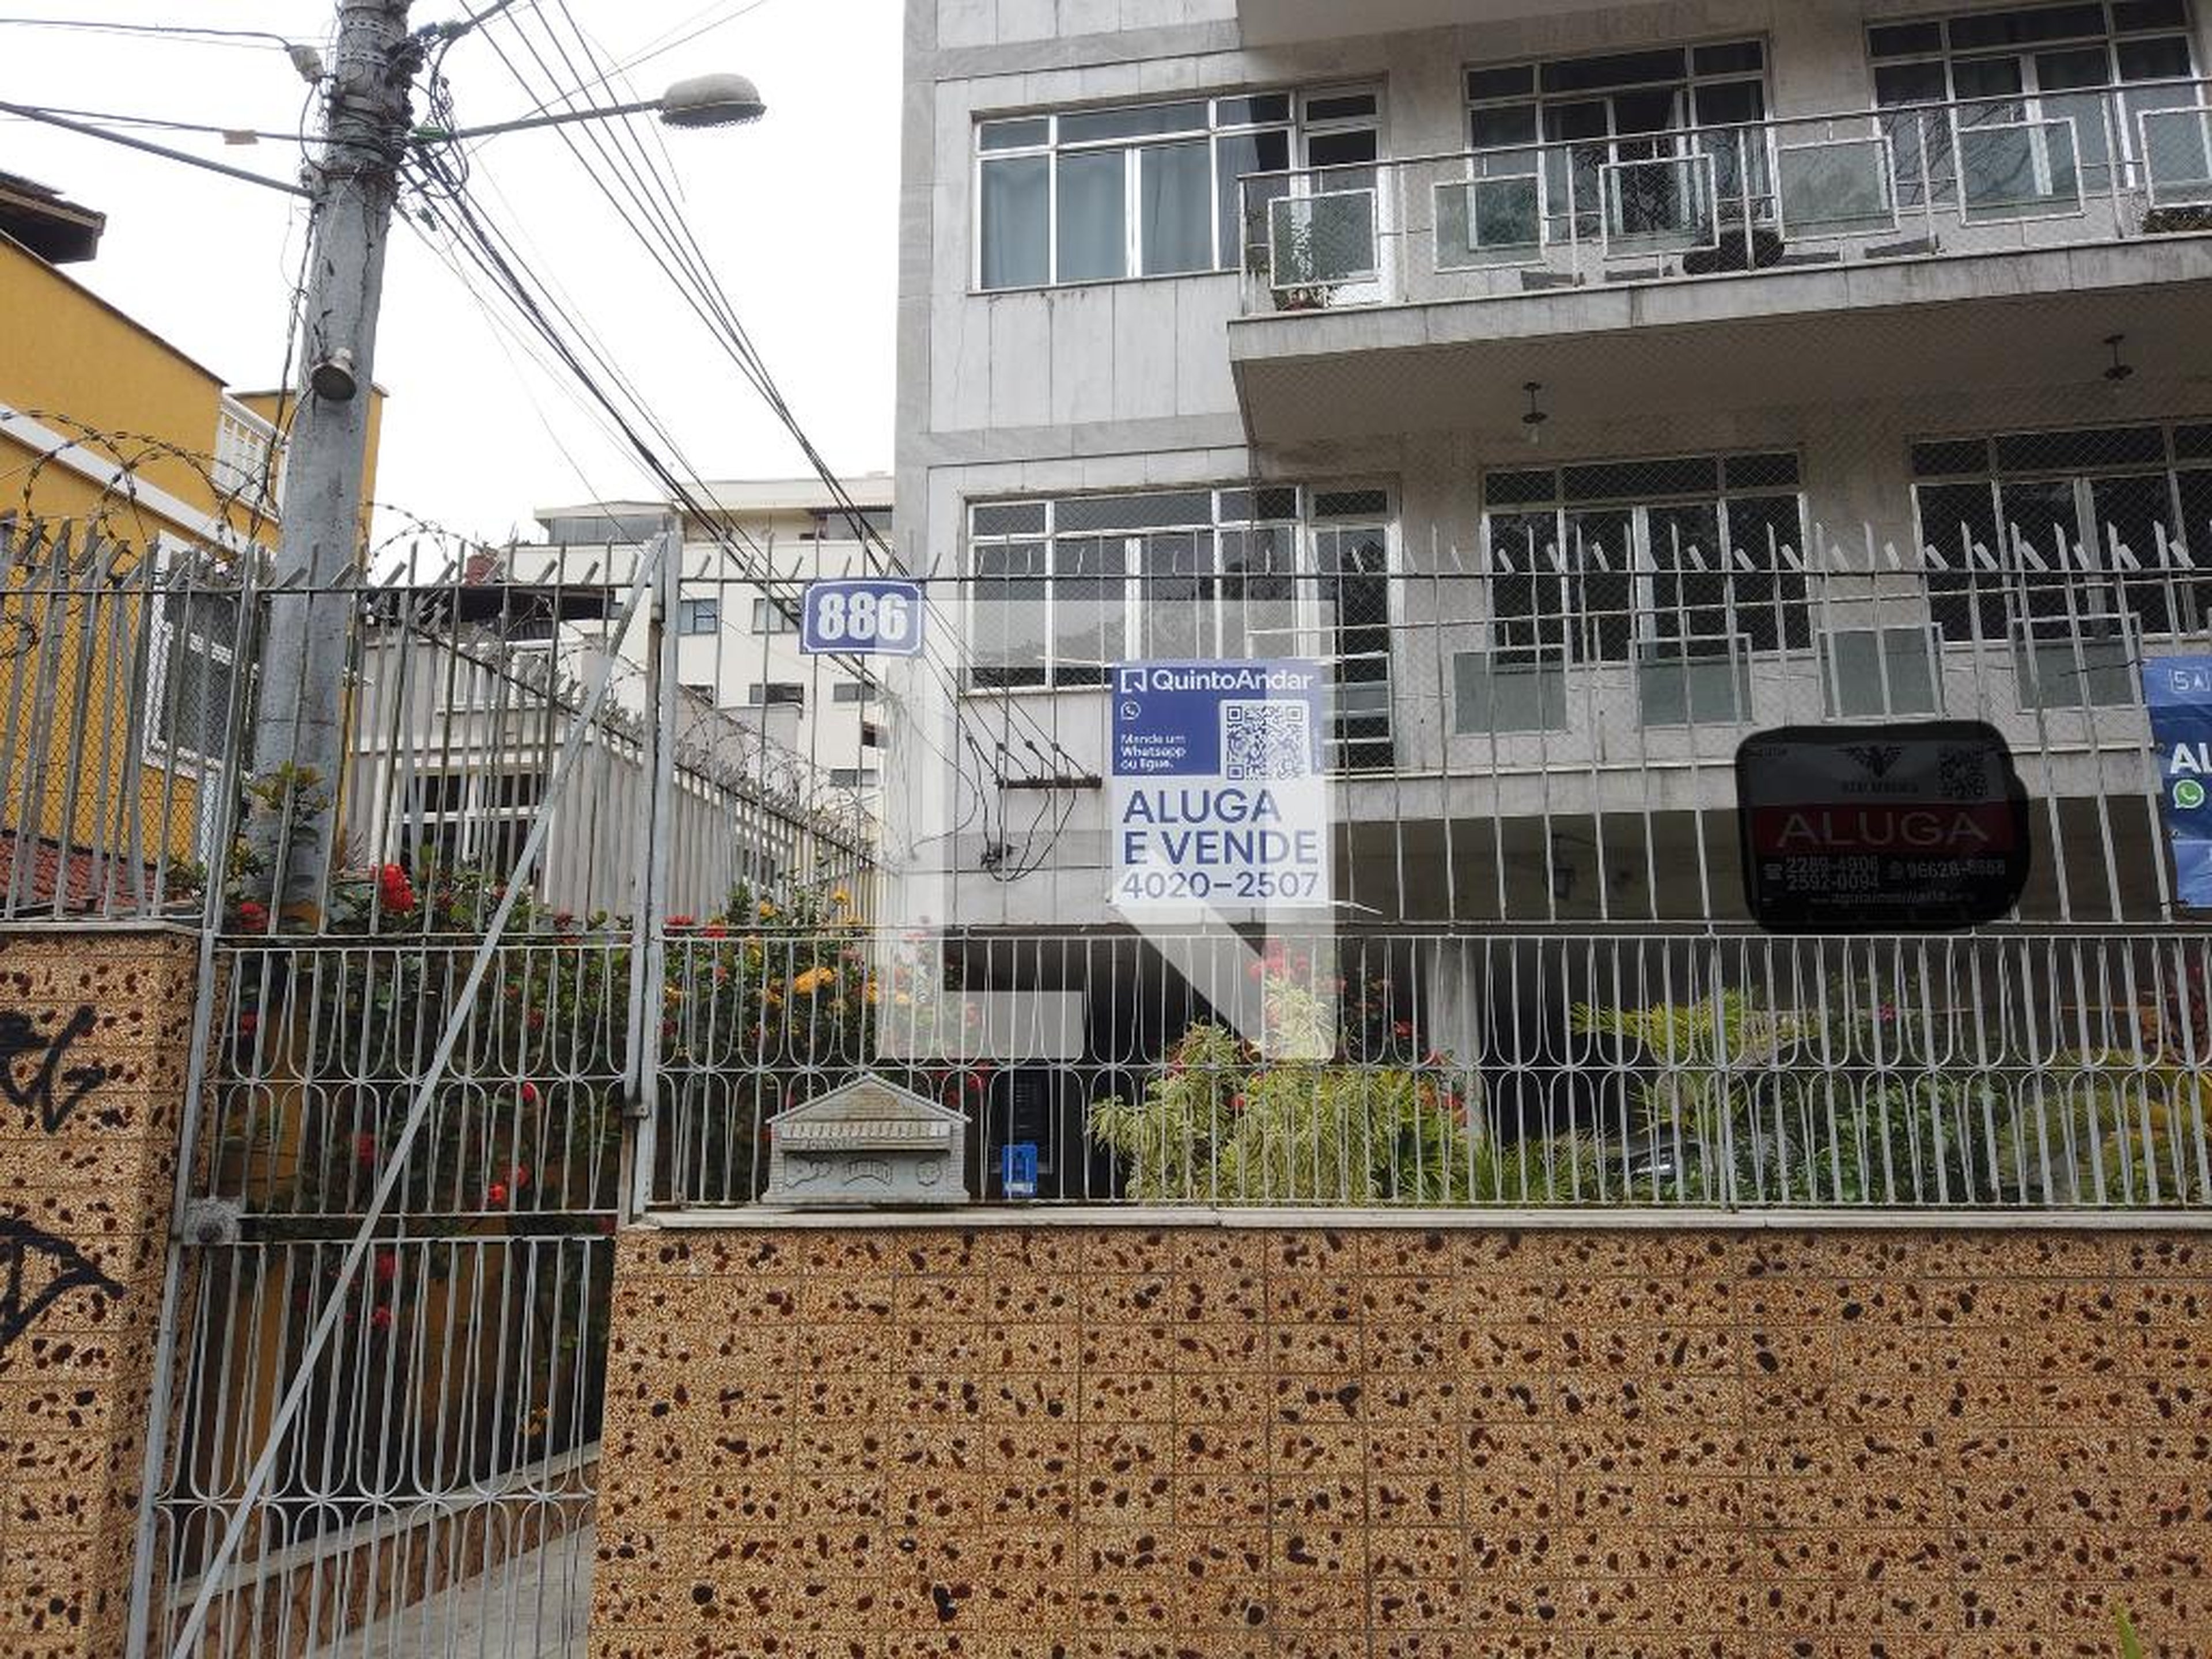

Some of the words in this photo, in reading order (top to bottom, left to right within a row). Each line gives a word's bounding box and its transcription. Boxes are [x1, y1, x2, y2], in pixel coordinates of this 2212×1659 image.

[817, 591, 908, 641] 886
[1153, 669, 1314, 691] QuintoAndar
[1122, 788, 1282, 824] ALUGA
[1777, 811, 1990, 847] ALUGA
[1124, 830, 1148, 865] E
[1160, 830, 1319, 865] VENDE
[1123, 870, 1319, 899] 4020-2507
